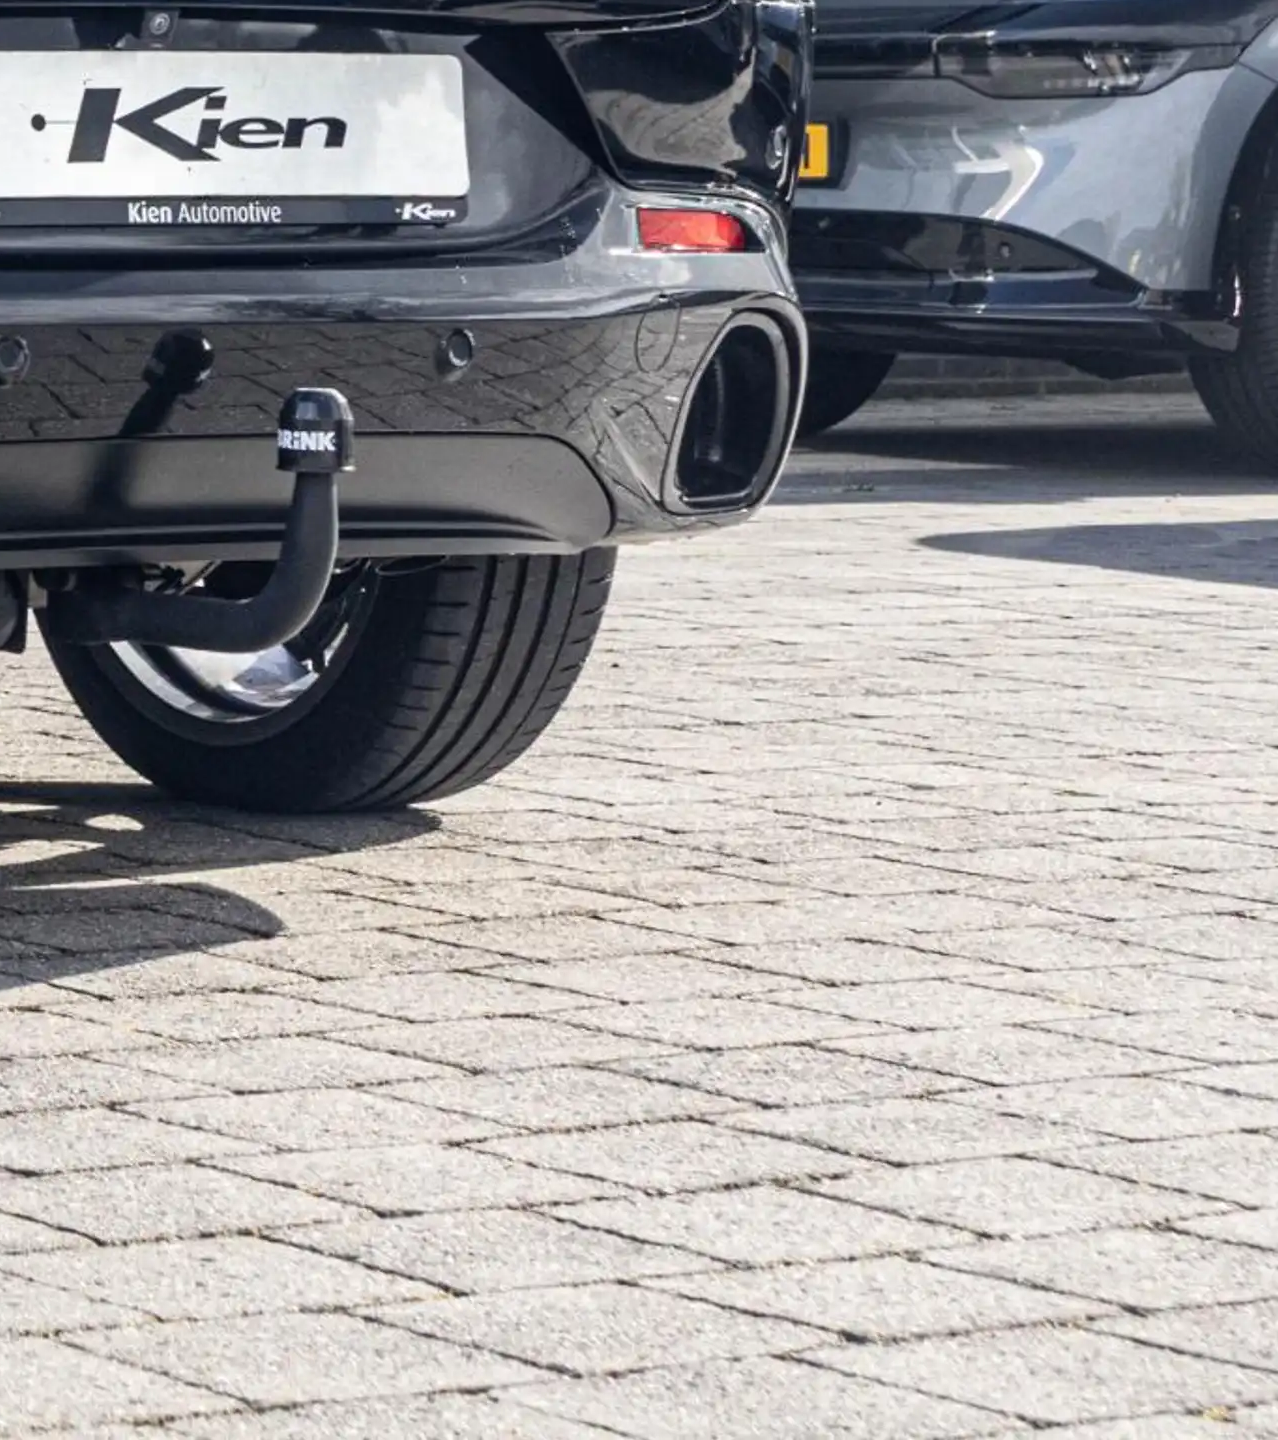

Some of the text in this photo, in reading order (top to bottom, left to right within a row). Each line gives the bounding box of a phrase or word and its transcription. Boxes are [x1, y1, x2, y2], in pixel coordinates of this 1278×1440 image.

[67, 86, 348, 164] Kien
[128, 202, 282, 224] Kien Automotive
[402, 203, 457, 221] Kien
